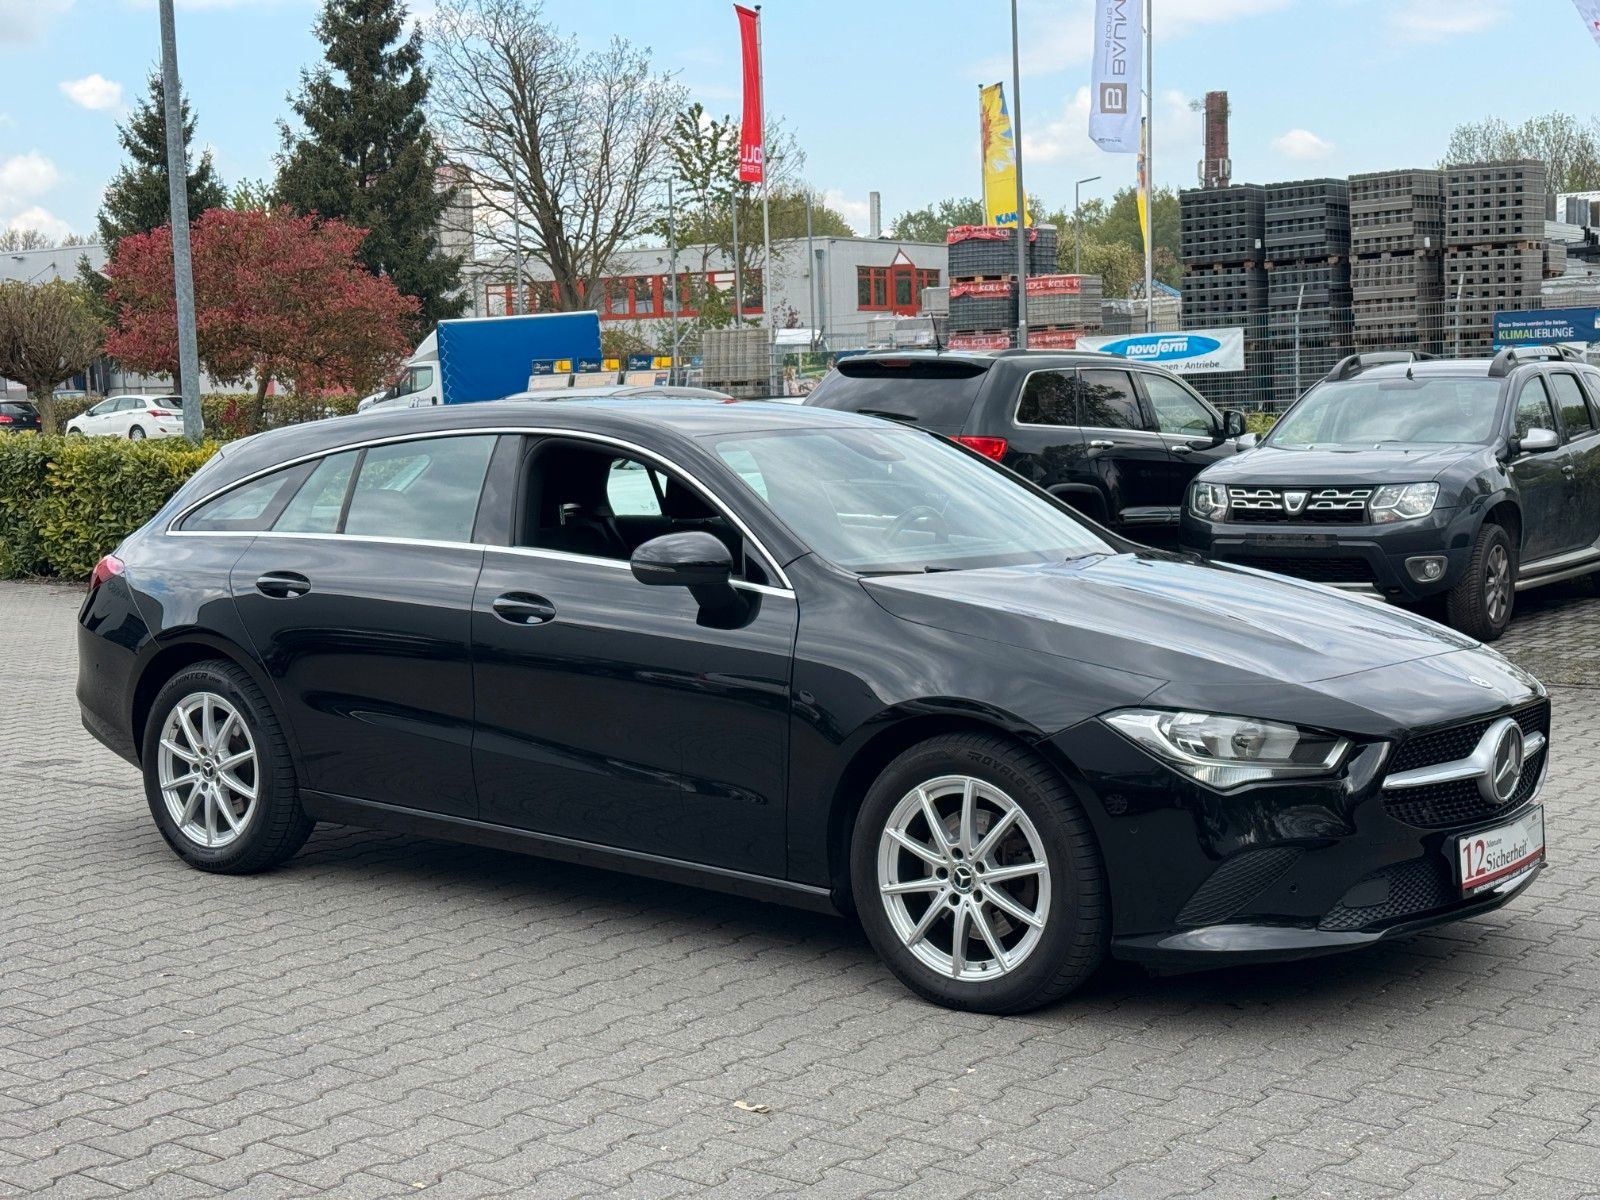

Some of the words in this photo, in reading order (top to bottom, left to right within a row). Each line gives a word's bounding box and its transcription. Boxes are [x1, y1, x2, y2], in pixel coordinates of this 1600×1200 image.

[1048, 279, 1070, 288] KOLL
[1499, 327, 1574, 340] KLIMALIEBLINGE
[971, 338, 992, 347] KOLL
[1126, 337, 1189, 359] novoferm
[1184, 359, 1220, 370] Antriebe
[1463, 839, 1486, 880] 12
